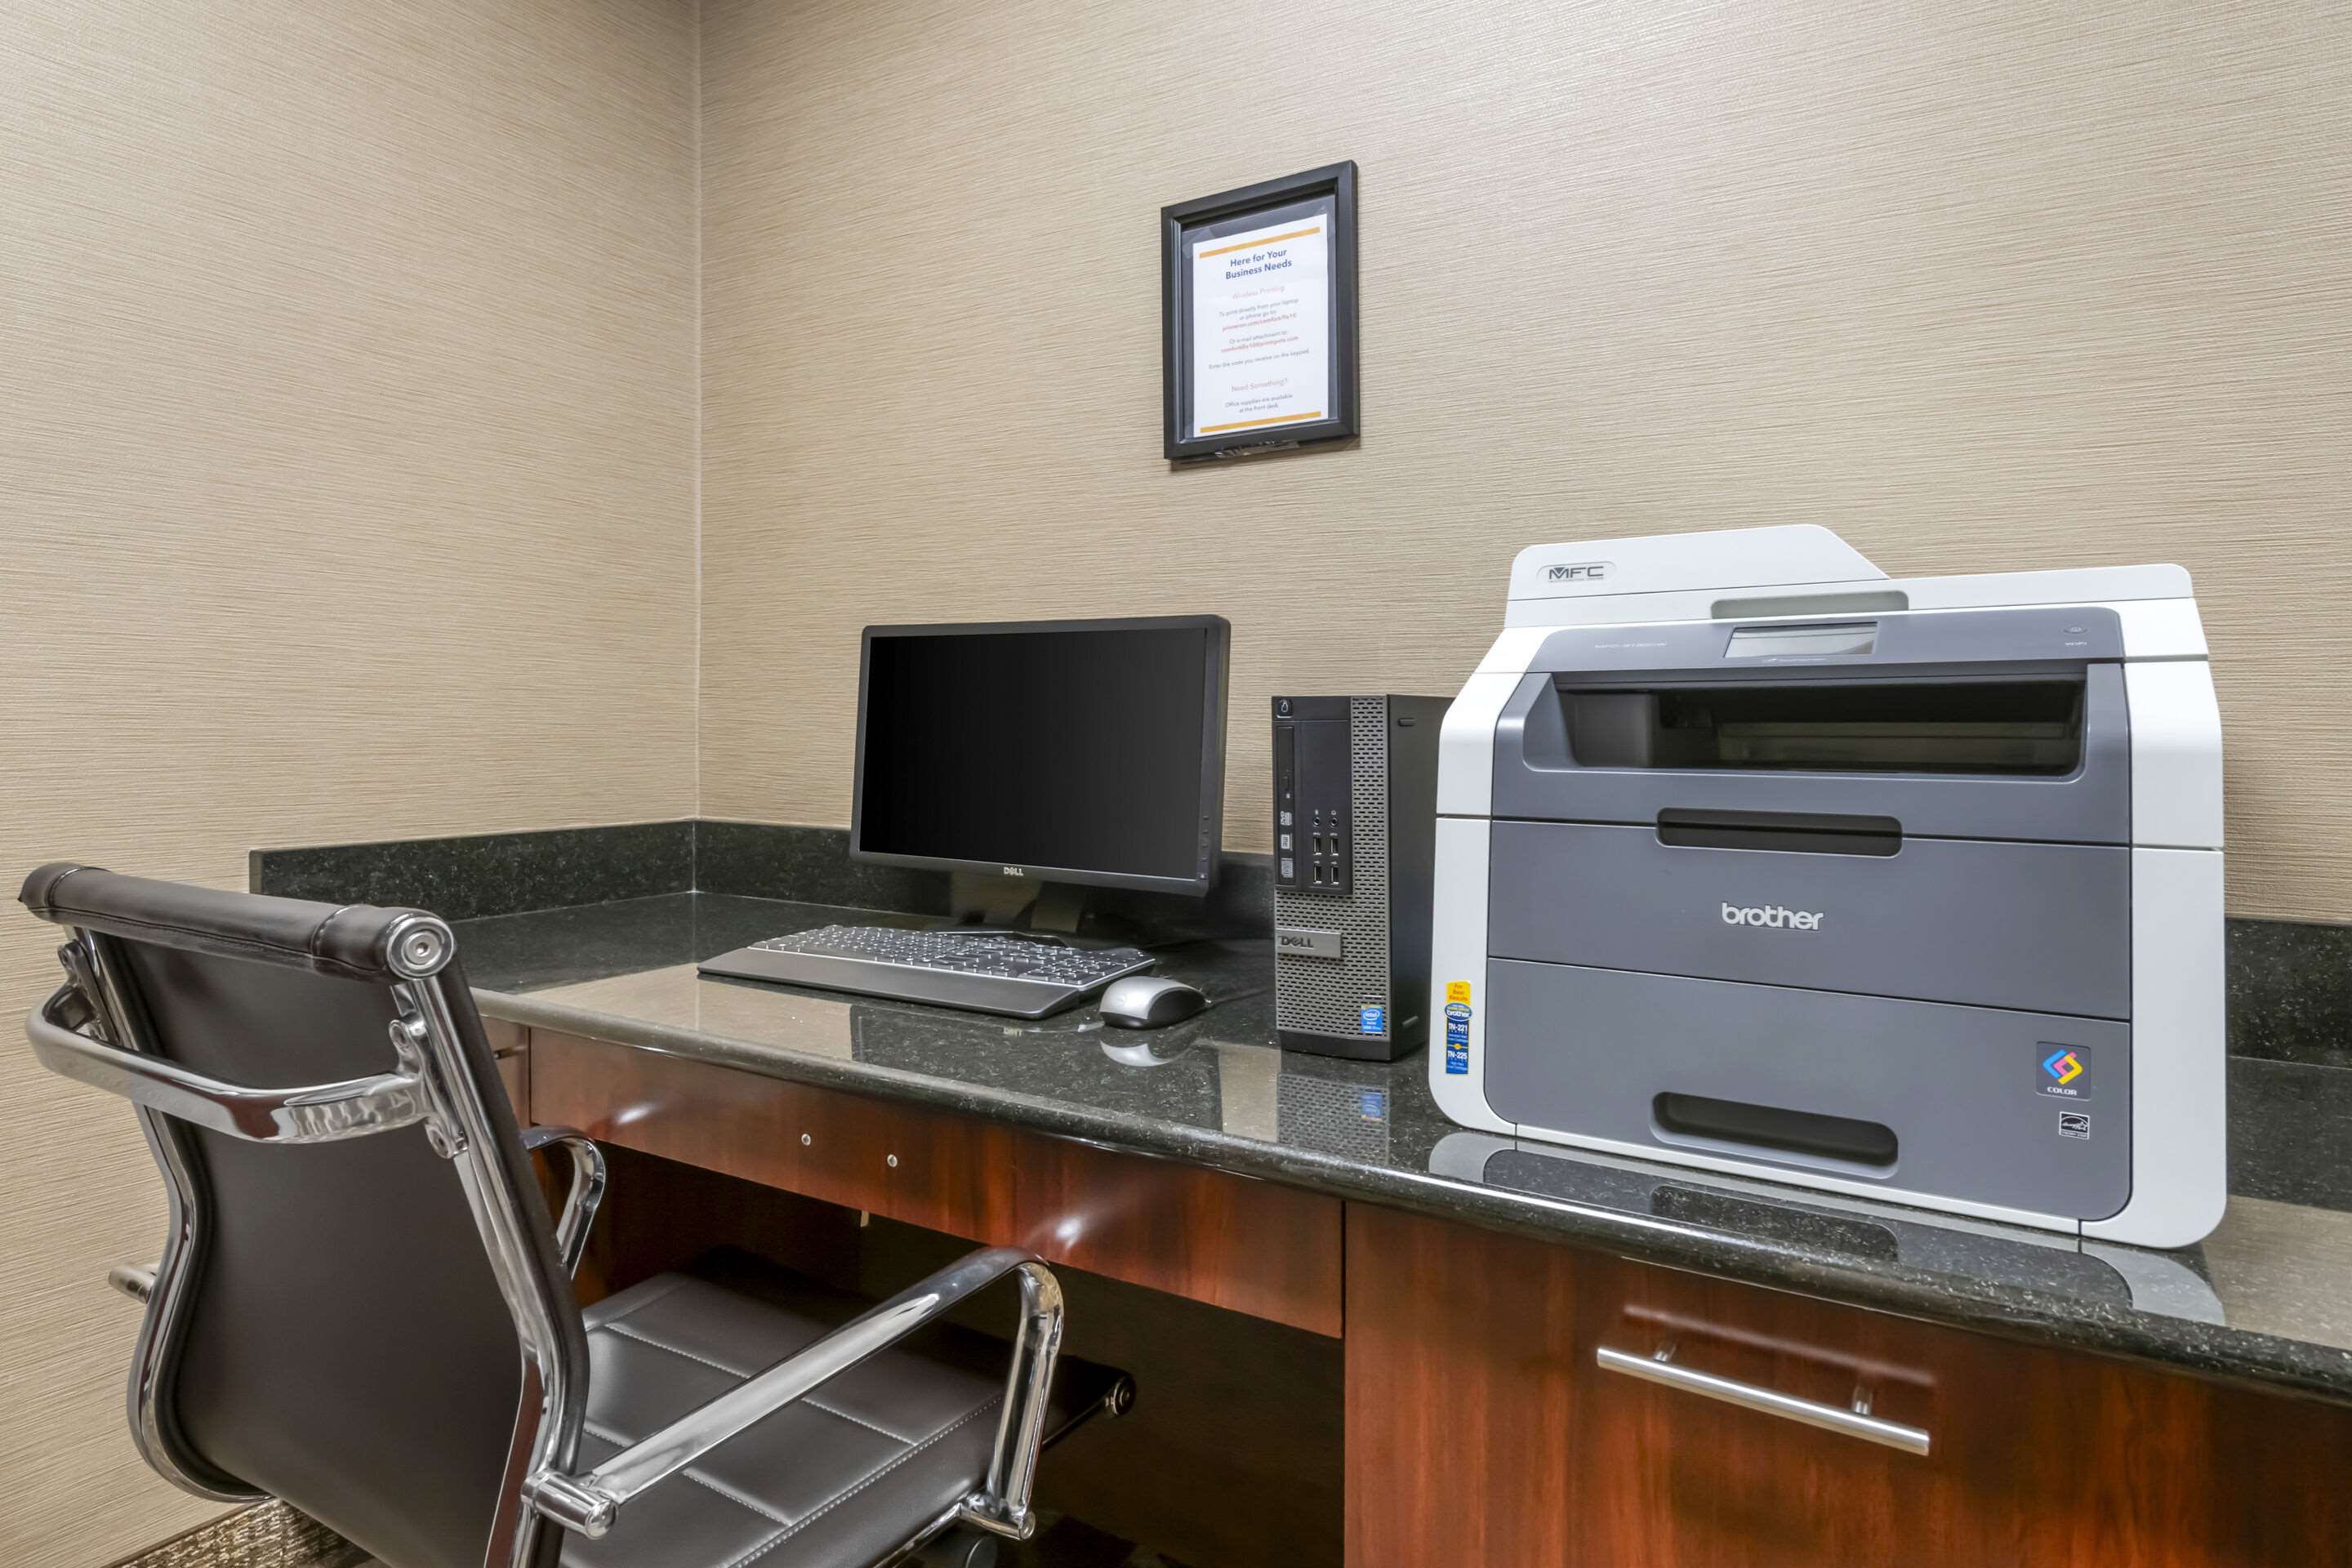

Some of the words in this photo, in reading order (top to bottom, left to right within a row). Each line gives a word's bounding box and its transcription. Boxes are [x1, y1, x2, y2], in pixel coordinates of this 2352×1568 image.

[1230, 258, 1250, 267] Here
[1253, 254, 1265, 262] for
[1267, 249, 1287, 259] Your
[1225, 267, 1262, 279] Business
[1265, 259, 1292, 271] Needs
[1231, 383, 1249, 393] Need
[1250, 377, 1288, 390] Something?
[1548, 566, 1604, 579] MFC
[1003, 866, 1024, 876] DELL
[1722, 902, 1824, 930] brother
[1280, 936, 1314, 948] DELL
[1448, 1022, 1468, 1032] TN-221
[1447, 1050, 1468, 1059] TN-225
[2047, 1086, 2078, 1096] COLOR
